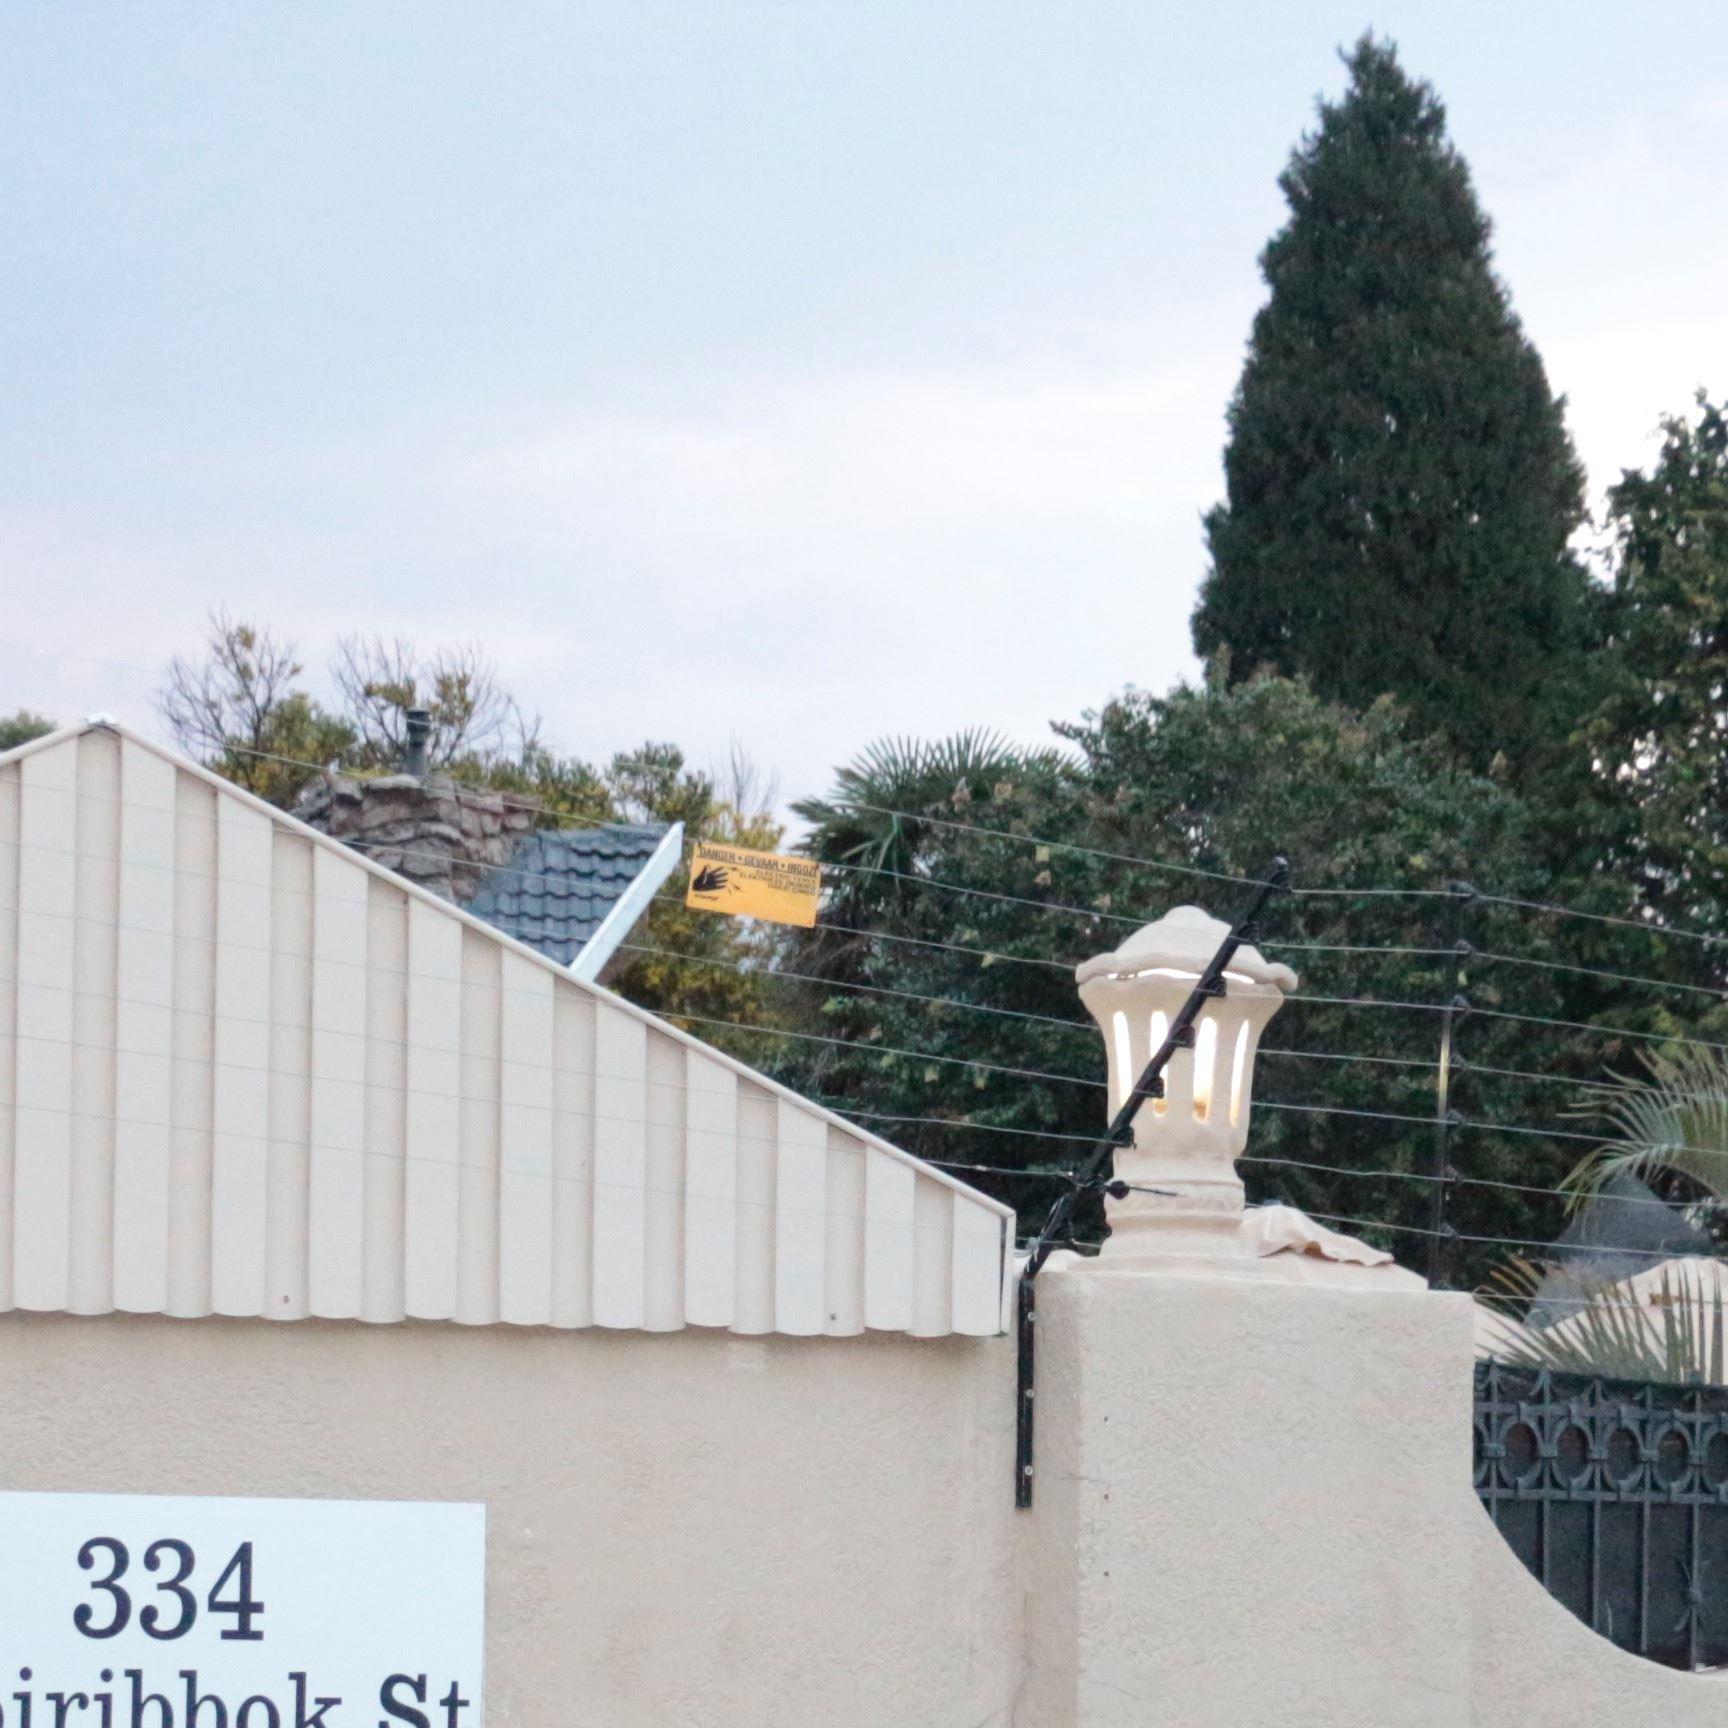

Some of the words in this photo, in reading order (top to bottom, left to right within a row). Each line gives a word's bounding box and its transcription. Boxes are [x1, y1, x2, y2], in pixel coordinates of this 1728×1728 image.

[699, 847, 736, 863] DANGER
[744, 855, 779, 869] GEVAAR
[72, 1536, 265, 1641] 334
